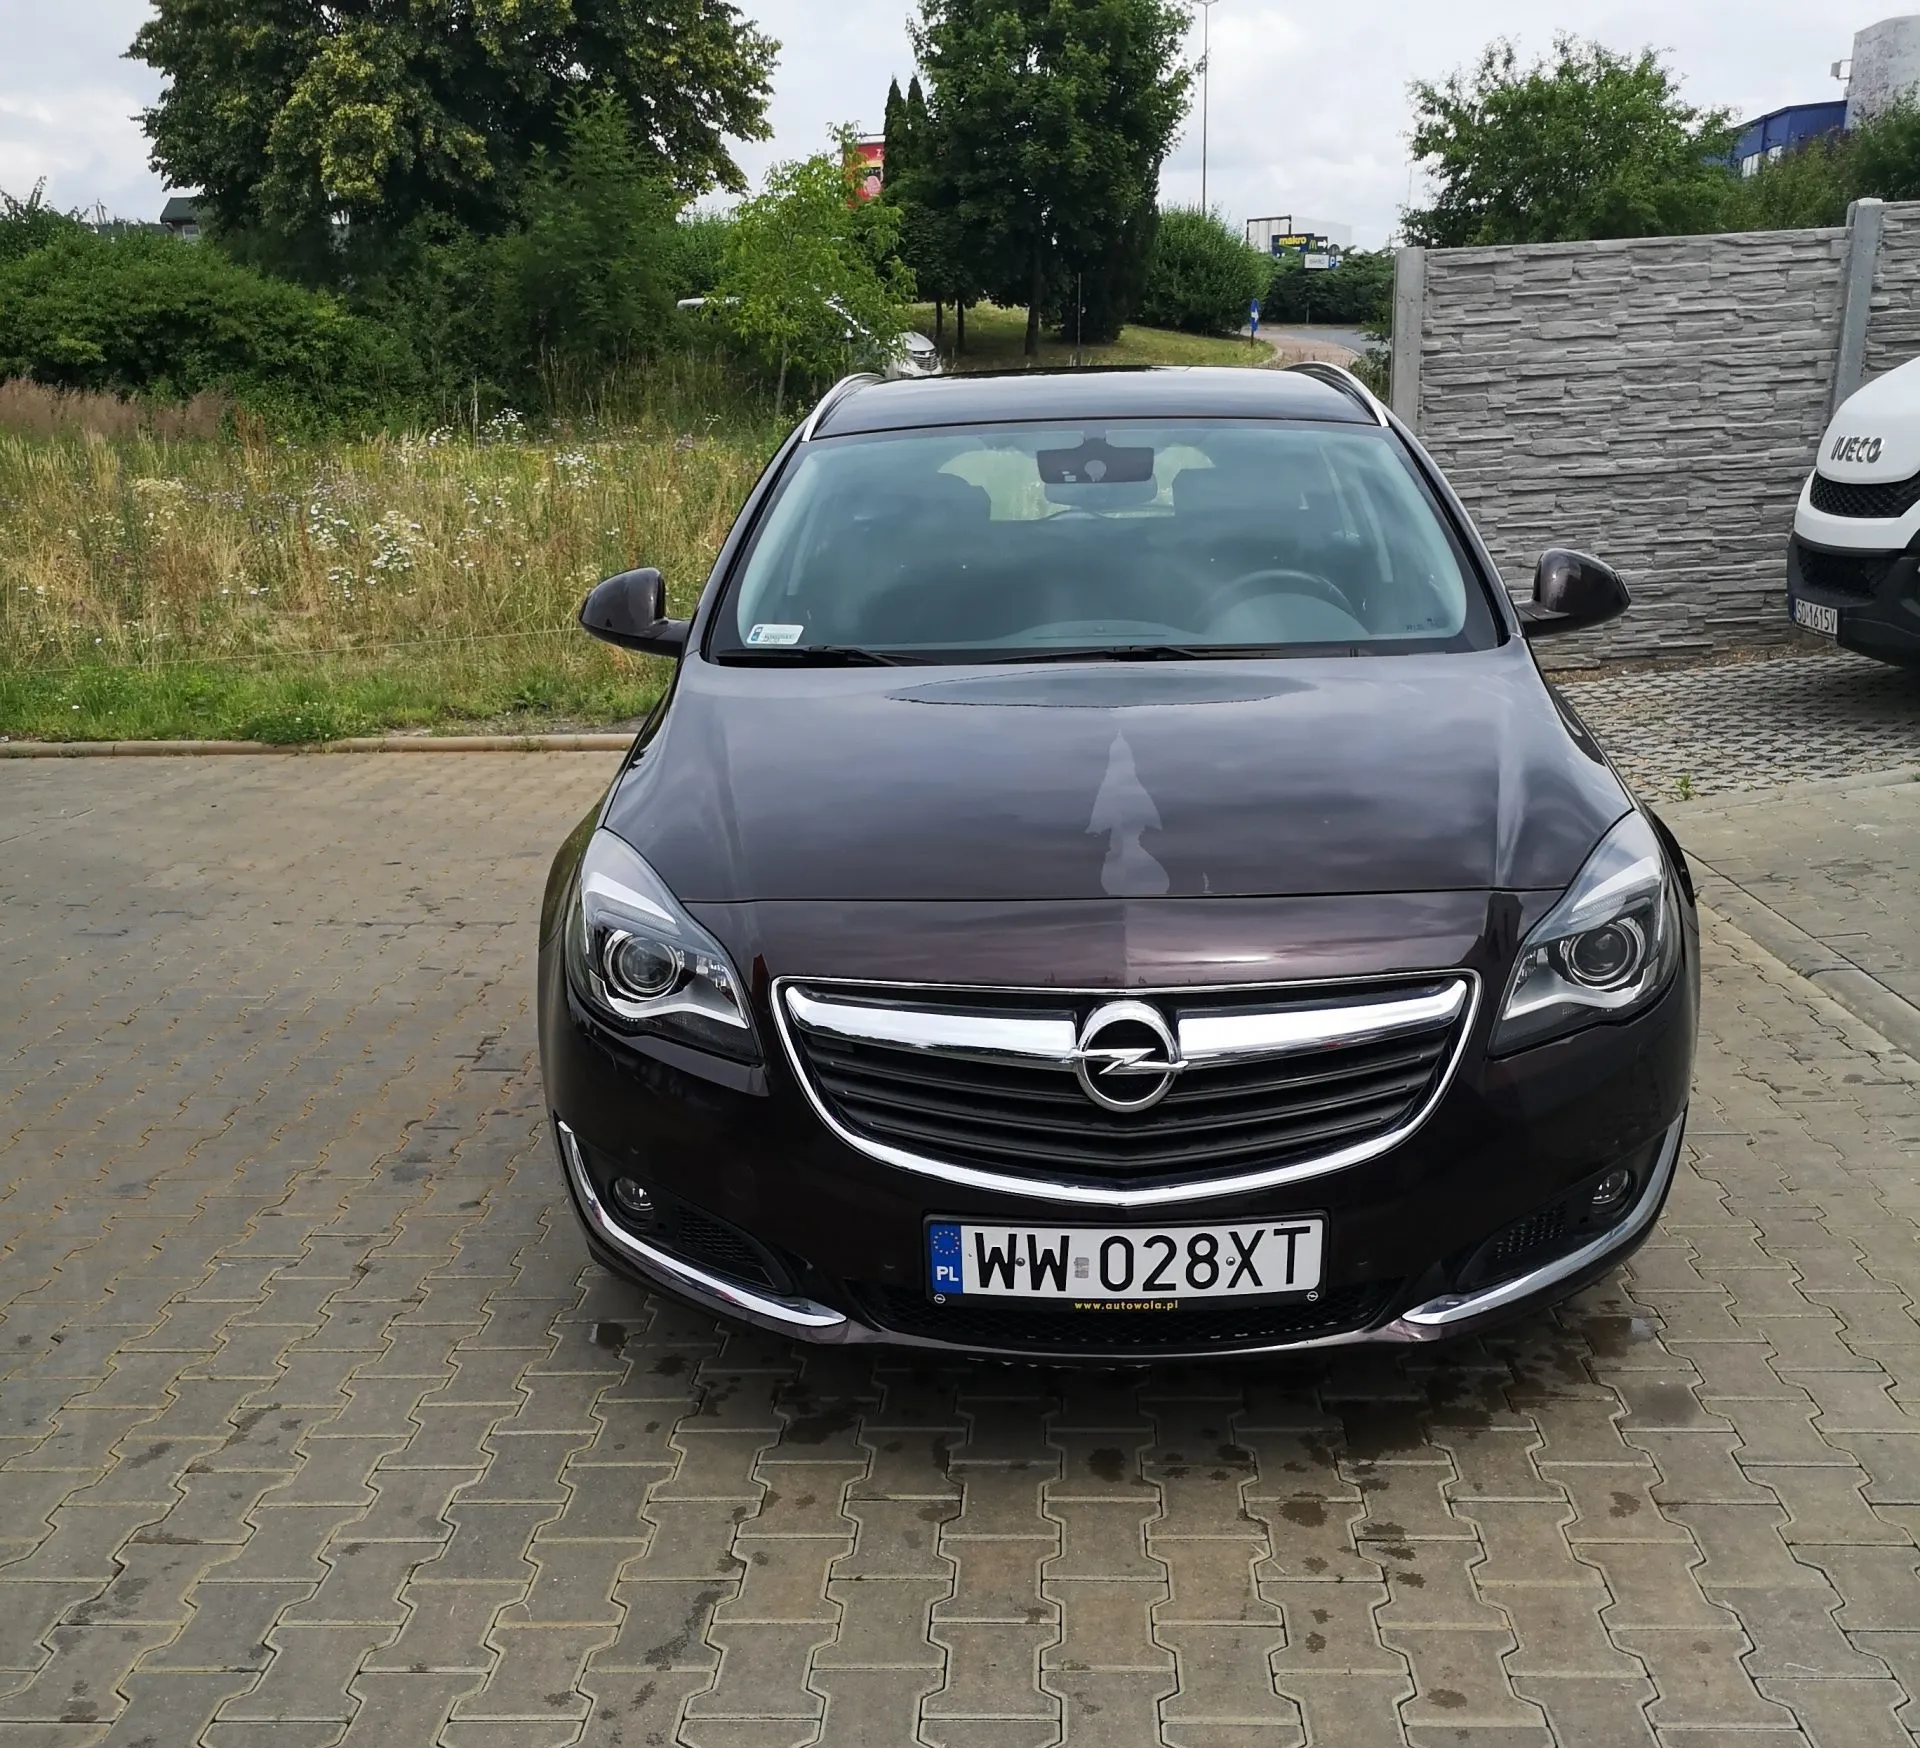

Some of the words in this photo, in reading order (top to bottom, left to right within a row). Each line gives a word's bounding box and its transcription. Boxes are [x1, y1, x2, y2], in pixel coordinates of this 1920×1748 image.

[1279, 235, 1307, 245] makro
[1830, 436, 1883, 463] IVECO
[975, 1232, 1070, 1291] WW
[1100, 1226, 1311, 1292] 028XT
[936, 1266, 959, 1281] PL
[1074, 1299, 1178, 1310] www.autowola.pl
